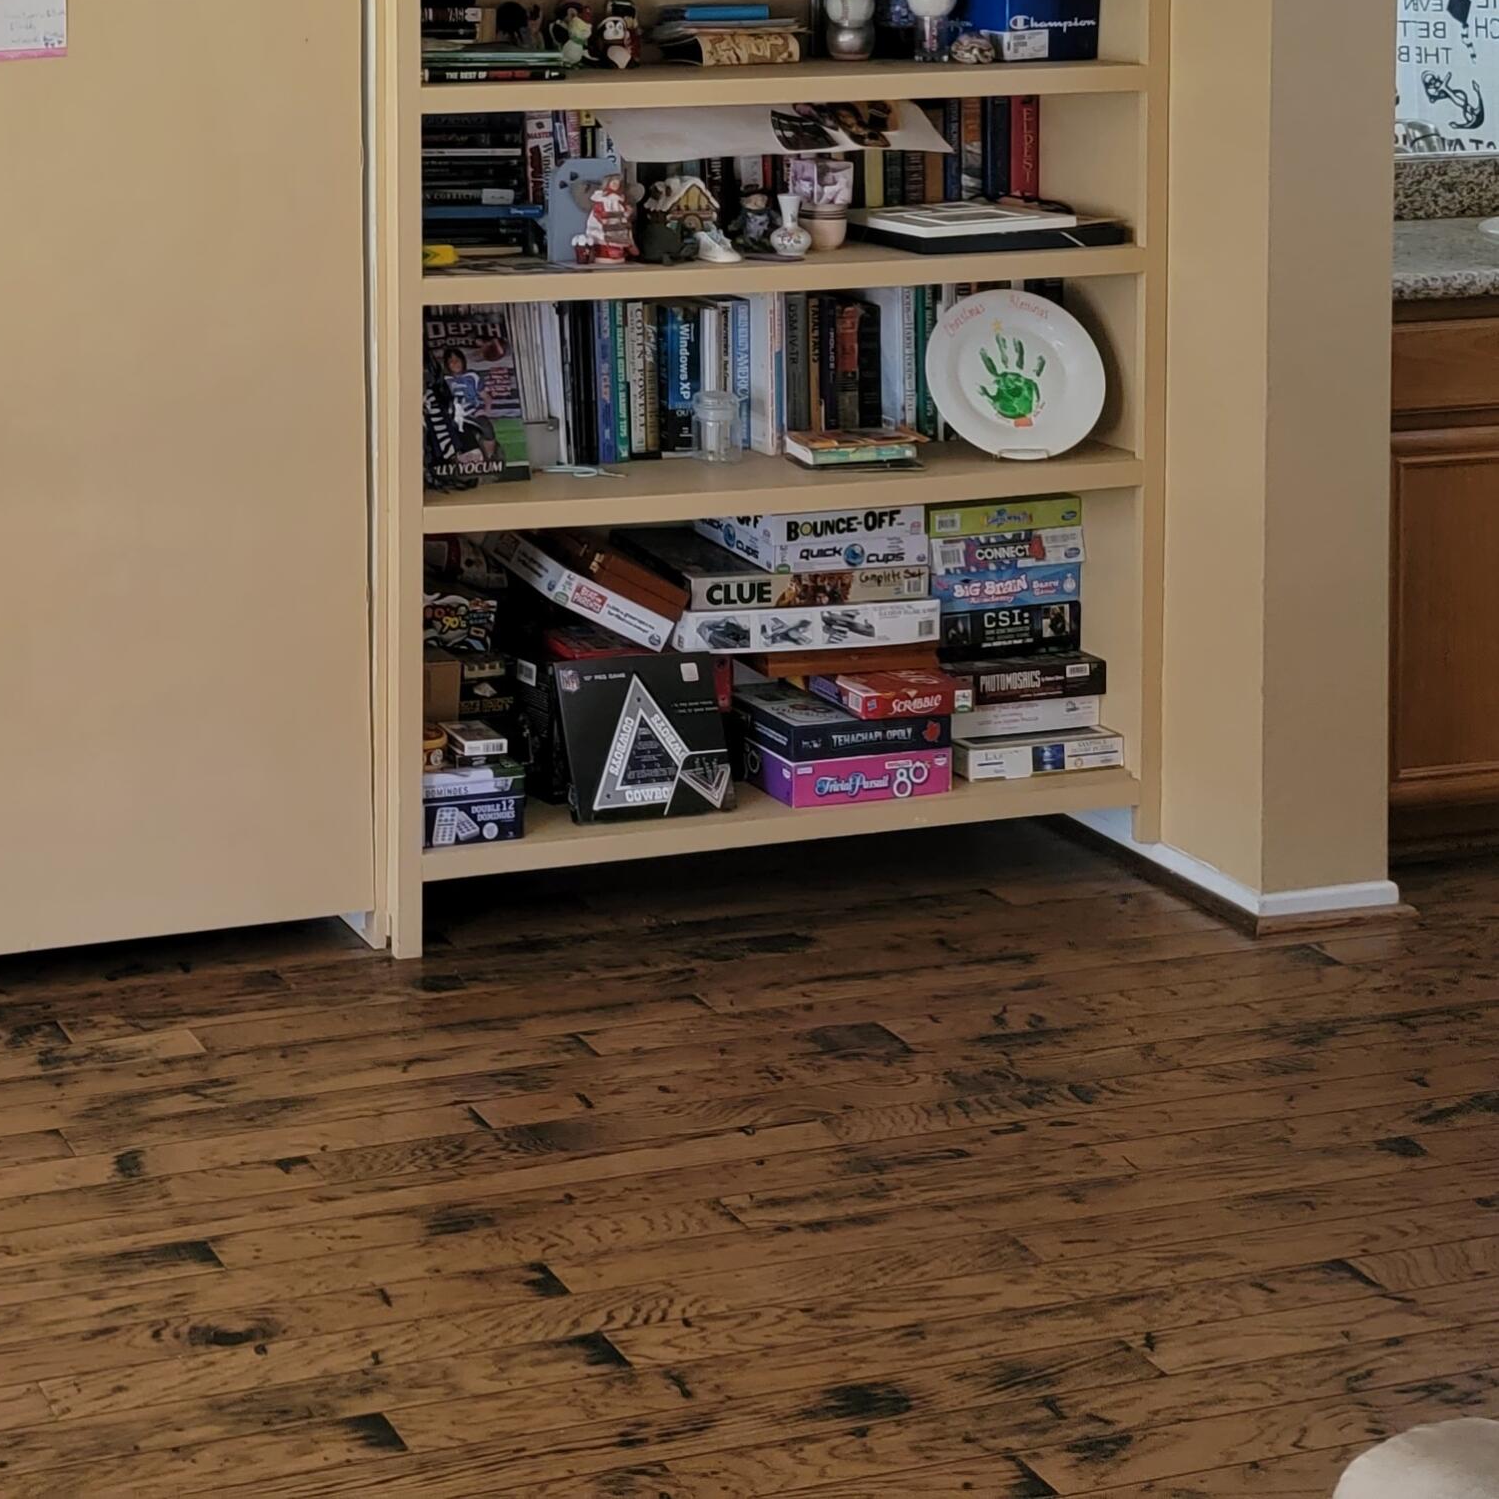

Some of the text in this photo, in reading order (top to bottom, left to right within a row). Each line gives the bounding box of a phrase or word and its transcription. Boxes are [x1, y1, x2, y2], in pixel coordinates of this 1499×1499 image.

[1009, 15, 1097, 33] Champion
[445, 71, 459, 80] THE
[459, 71, 477, 80] BEST
[477, 71, 487, 80] OF
[426, 321, 501, 339] DEPTH
[786, 303, 800, 365] DSM-IV-TR
[635, 308, 645, 429] COLIN POWELL
[678, 323, 691, 400] Windows XP
[736, 352, 750, 402] AMERICA
[457, 460, 503, 475] YOCUM
[786, 509, 901, 542] BOUNCE-OFF
[799, 546, 844, 561] QUICK
[975, 534, 1046, 562] CONNECT 4
[859, 570, 902, 588] Complete
[706, 581, 772, 606] CLUE
[953, 581, 982, 598] BIG
[983, 609, 1030, 629] CSI:
[979, 669, 1041, 694] PHOTOMOSAICS
[607, 716, 636, 777] COWBOYS
[831, 731, 883, 748] TEHACHAPI
[424, 785, 469, 797] DOMINOES
[815, 772, 890, 797] Trivial Pursuit
[625, 786, 670, 803] COWBO
[471, 799, 515, 814] DOUBLE 12
[476, 811, 516, 822] DOMINOES
